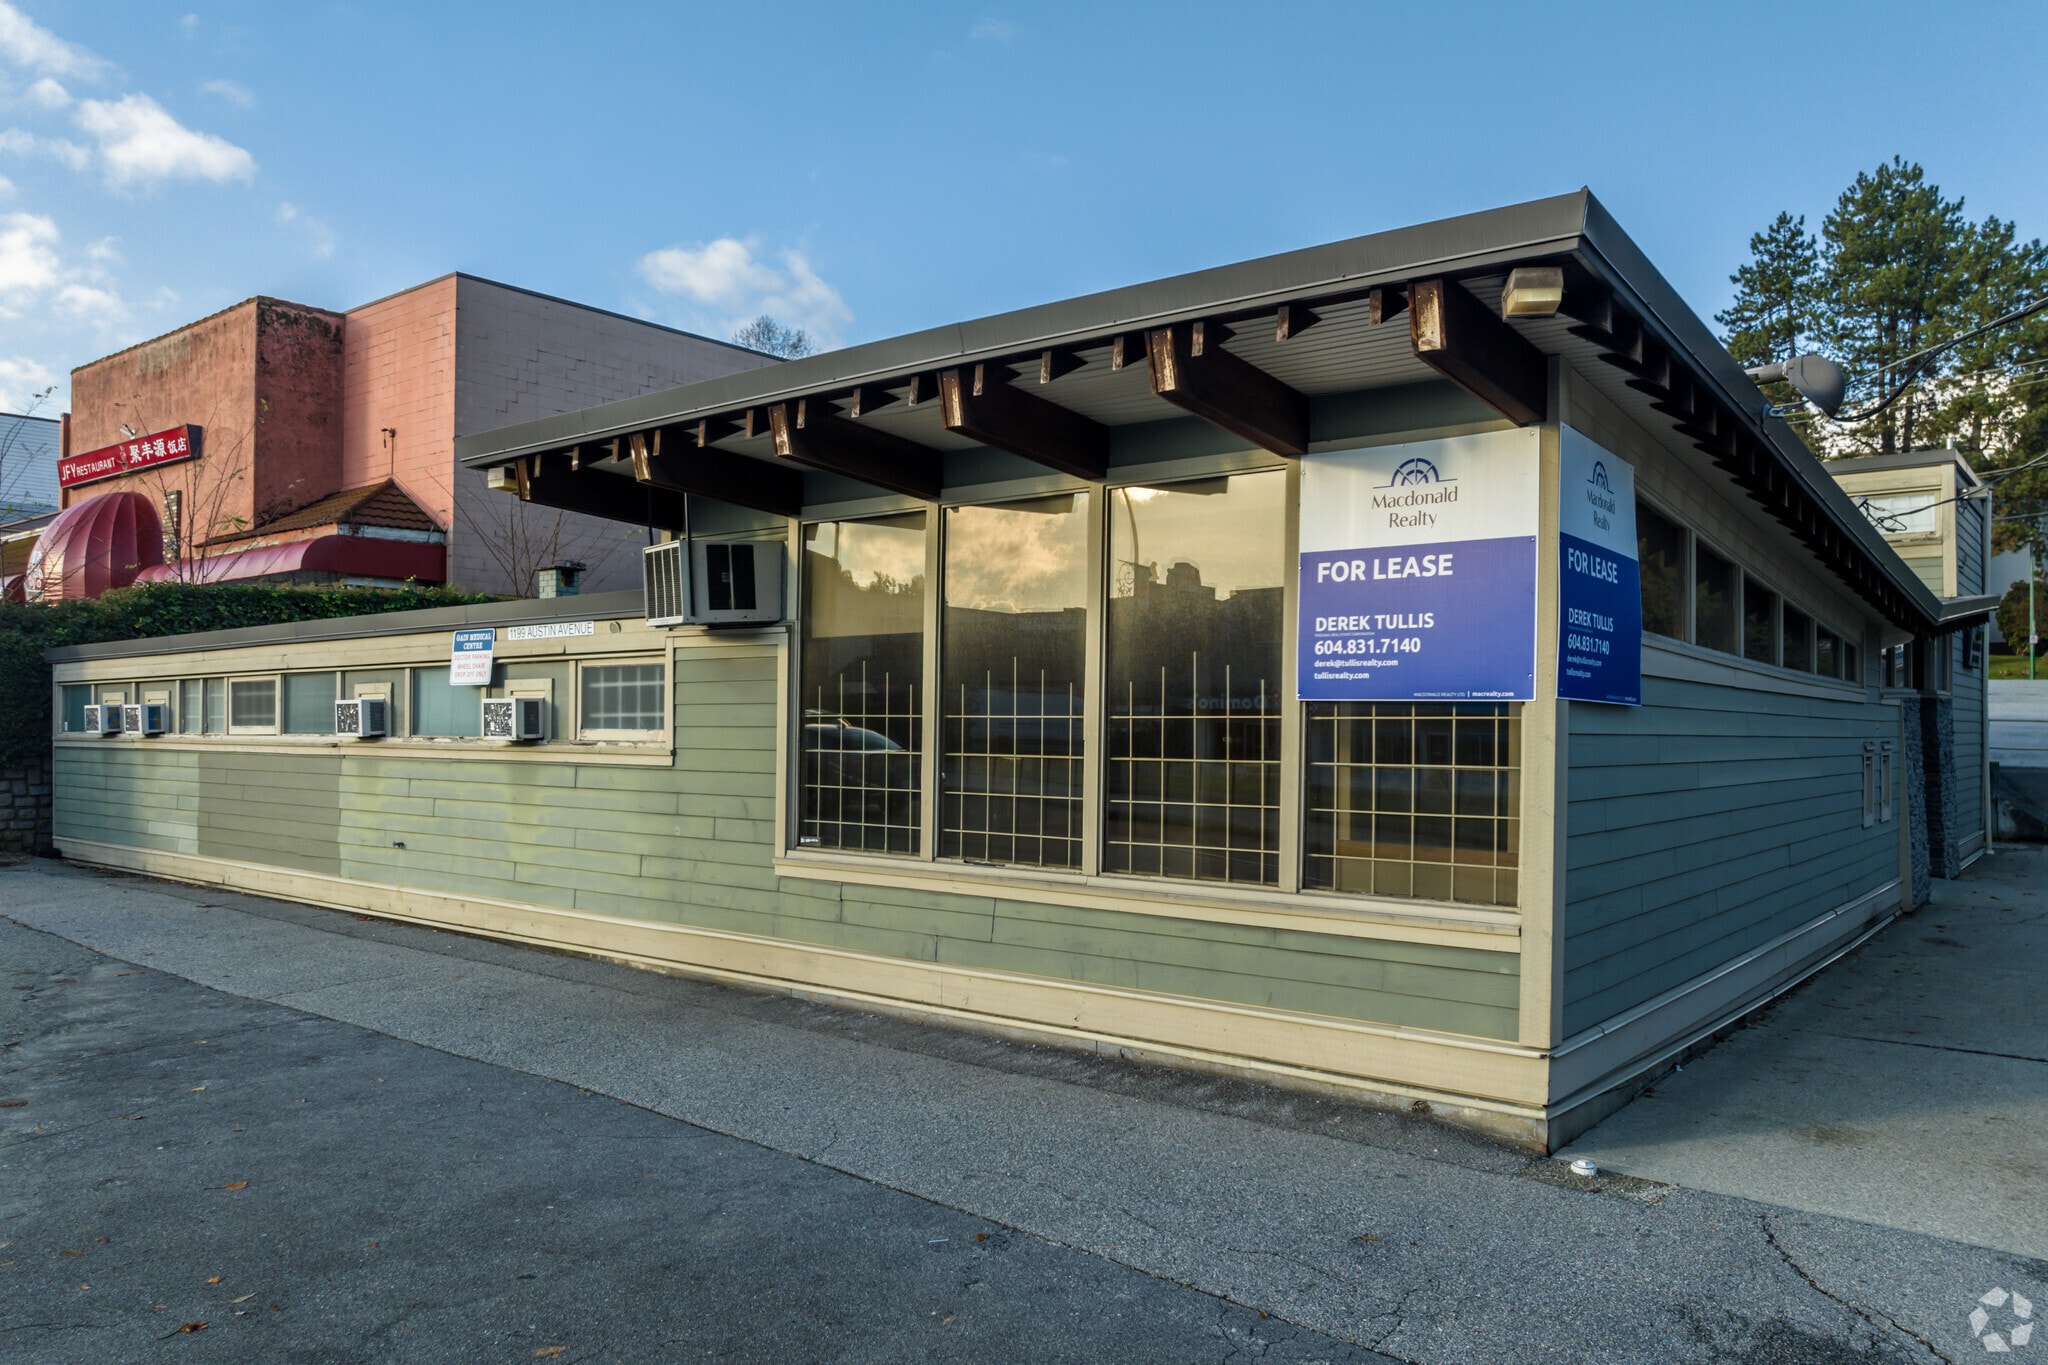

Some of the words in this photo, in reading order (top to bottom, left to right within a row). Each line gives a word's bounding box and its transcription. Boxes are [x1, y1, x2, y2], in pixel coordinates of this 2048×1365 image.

[62, 463, 77, 481] JFY
[76, 457, 115, 476] RESTAURANT
[1371, 486, 1458, 509] Macdonald
[1587, 489, 1616, 514] Macdonald
[1388, 511, 1438, 529] Realty
[1593, 511, 1610, 535] Realty
[1316, 559, 1366, 583] FOR
[1373, 554, 1454, 580] LEASE
[1568, 548, 1588, 575] FOR
[1590, 557, 1618, 583] LEASE
[509, 628, 526, 639] 1199
[527, 625, 557, 638] AUSTIN
[558, 622, 592, 636] AVENUE
[1315, 615, 1370, 632] DEREK
[1374, 612, 1435, 630] TULLIS
[1568, 608, 1592, 628] DEREK
[1593, 614, 1614, 633] TULLIS
[469, 632, 491, 641] MEDICAL
[1314, 637, 1421, 655] 604.831.7140
[1567, 633, 1609, 655] 604.831.7140
[1314, 659, 1399, 668] derek@tullisrealty.com
[1314, 672, 1370, 681] tullisrealty.com
